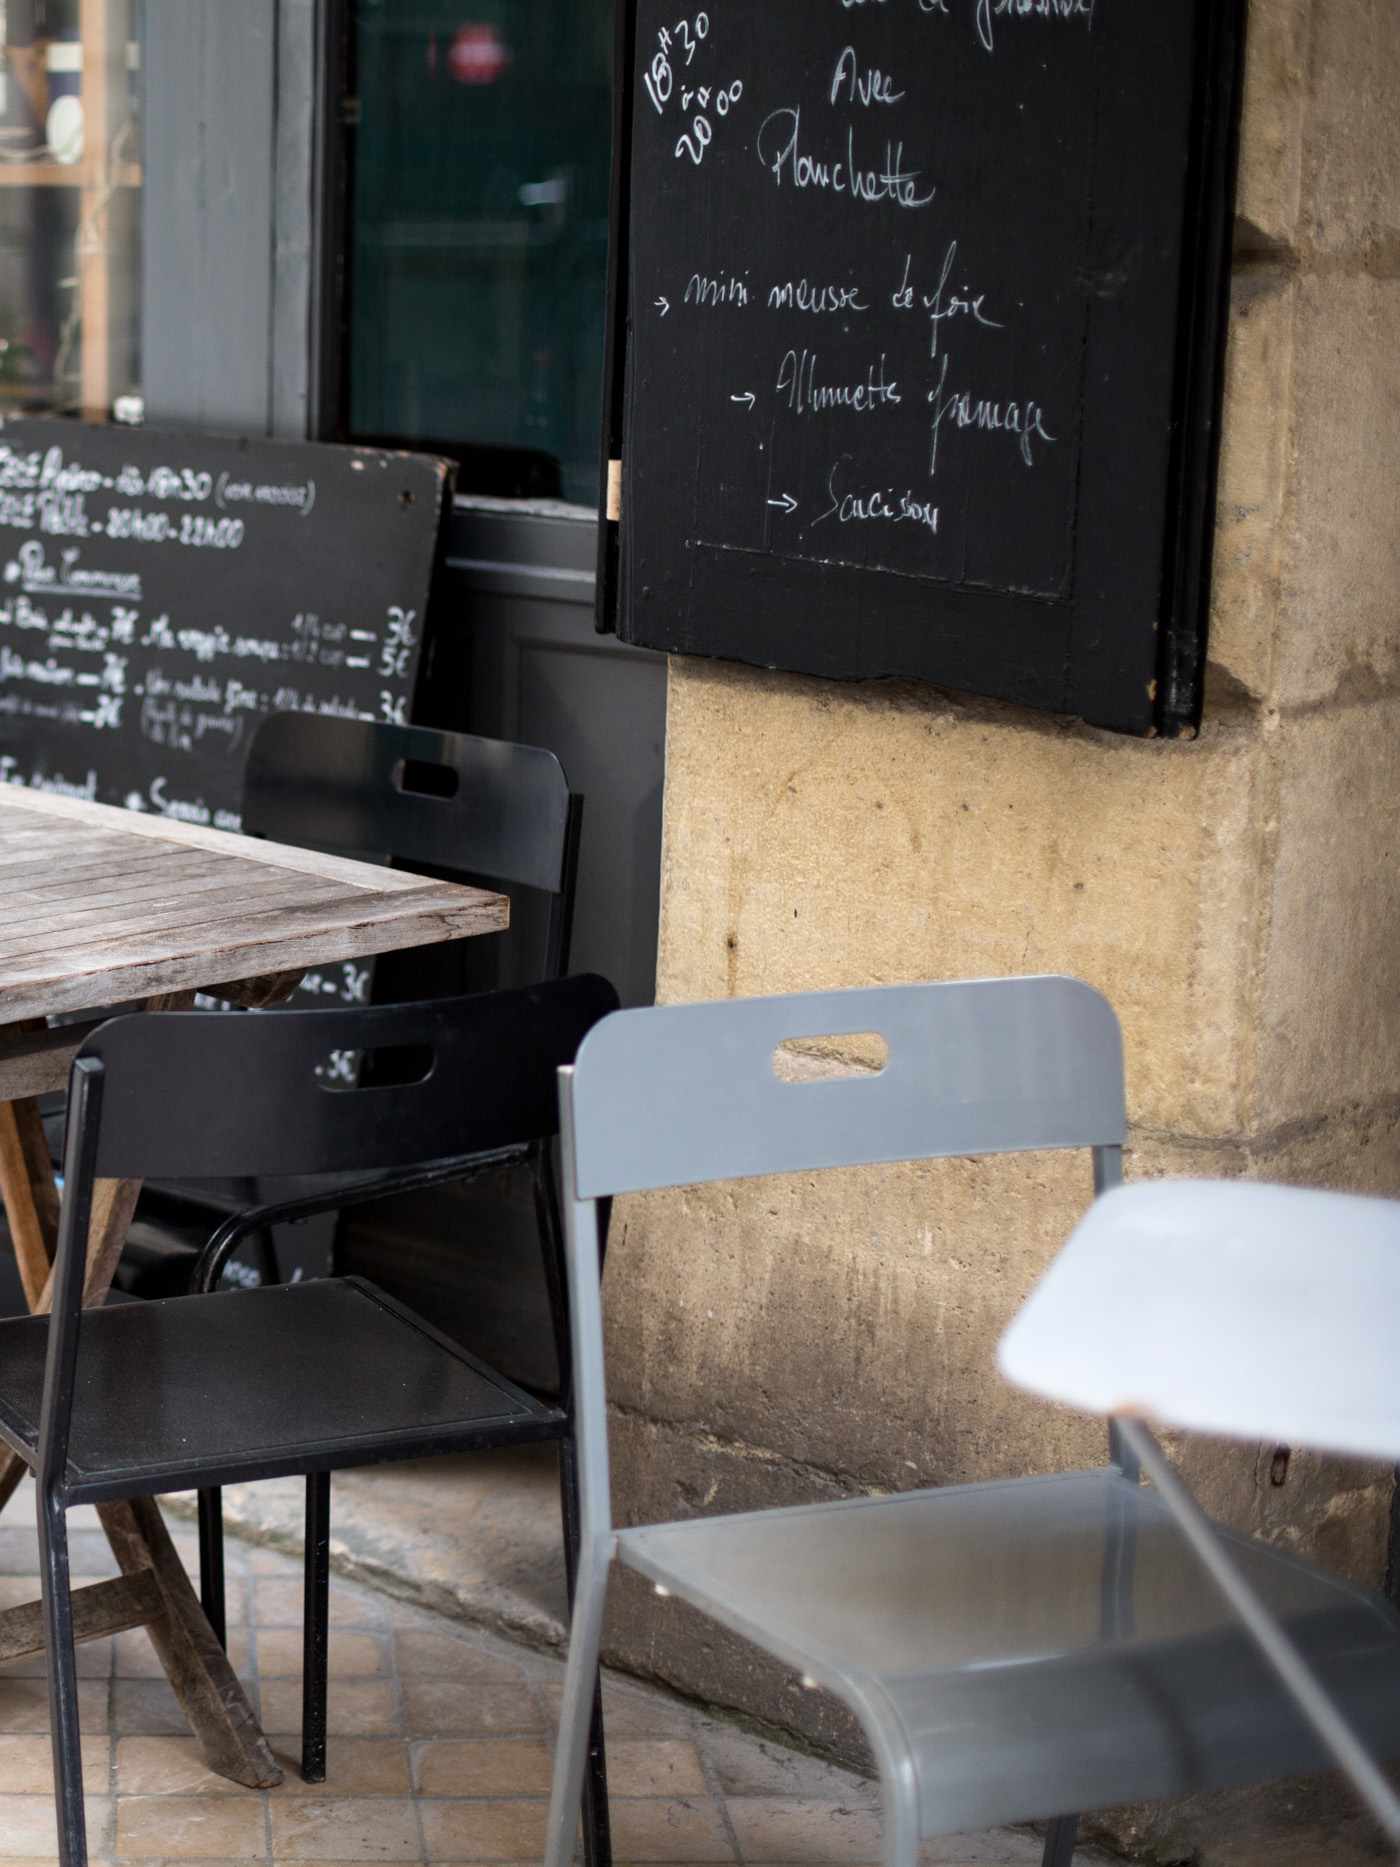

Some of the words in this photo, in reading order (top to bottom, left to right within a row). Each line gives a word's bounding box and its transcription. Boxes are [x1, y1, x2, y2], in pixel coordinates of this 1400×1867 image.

[756, 103, 937, 208] Planchette
[683, 270, 750, 307] mini
[382, 604, 418, 647] 3€
[375, 646, 412, 679] 5€
